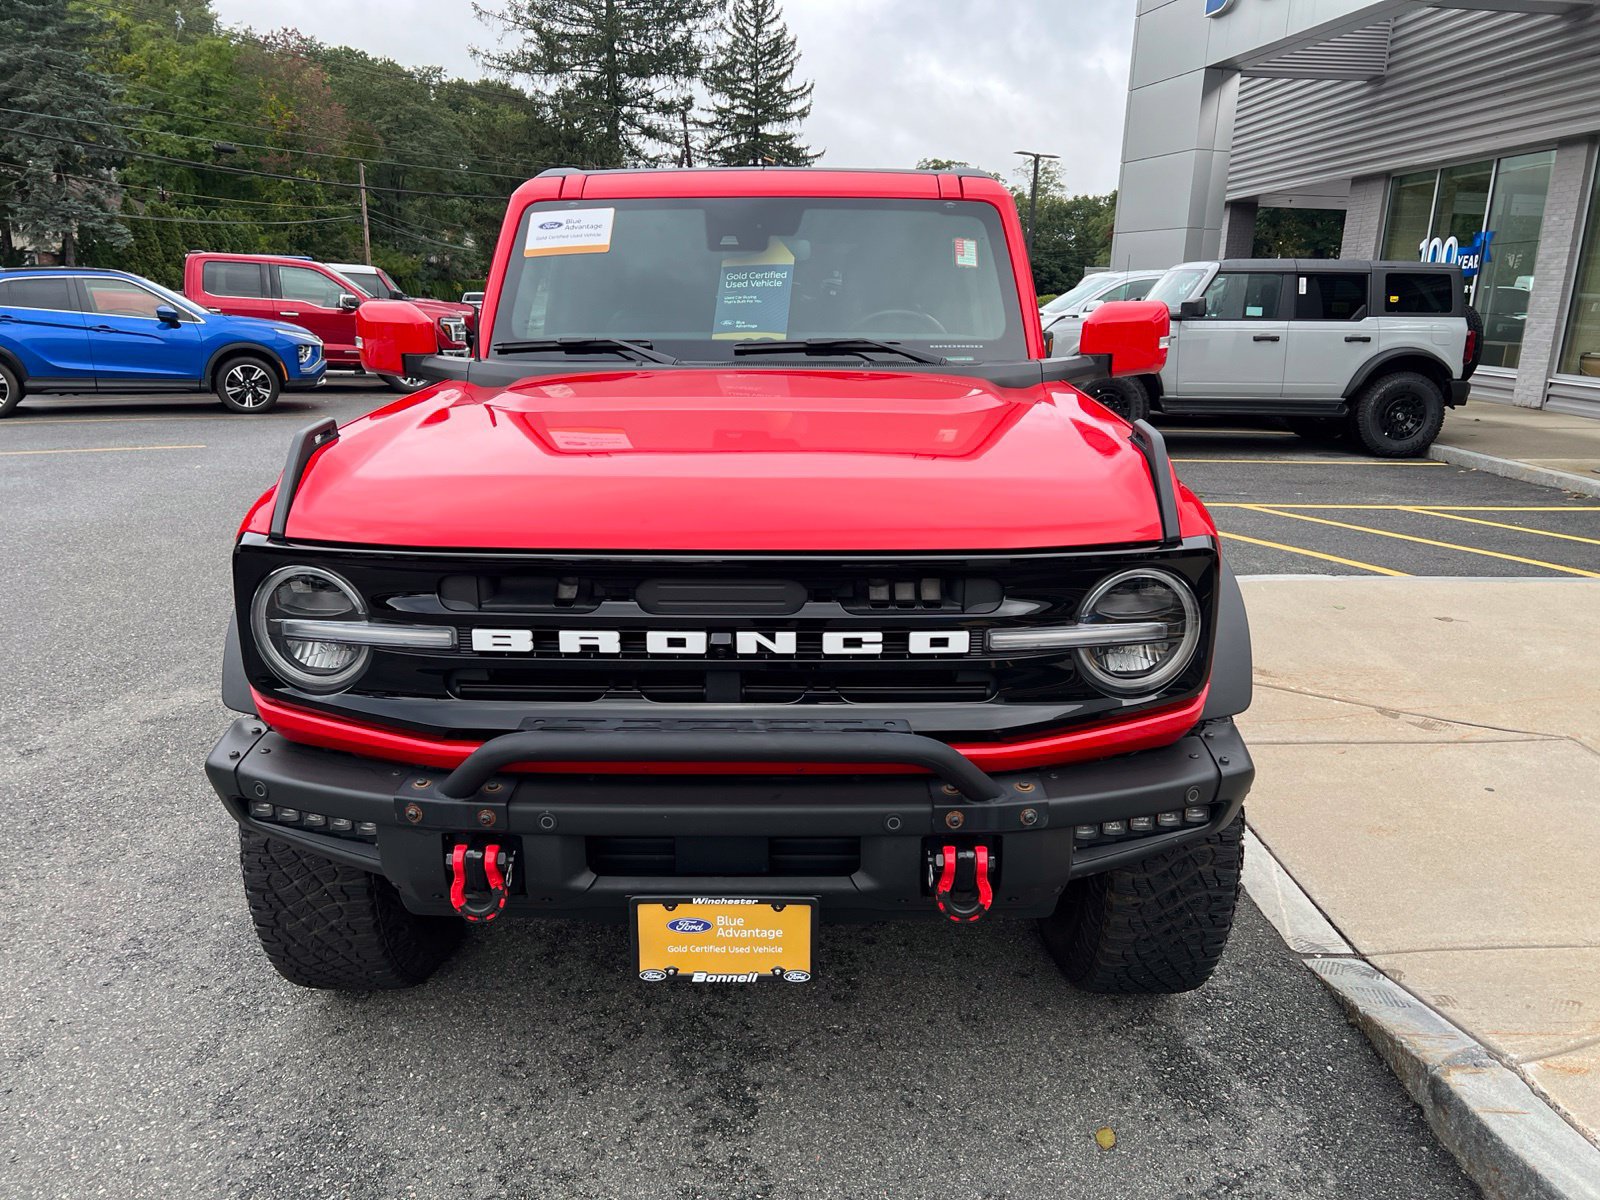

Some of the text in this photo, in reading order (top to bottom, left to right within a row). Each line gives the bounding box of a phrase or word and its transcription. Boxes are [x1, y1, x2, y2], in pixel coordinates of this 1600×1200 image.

[1419, 236, 1459, 264] 100
[726, 271, 788, 280] Gold Certified
[725, 279, 783, 288] Used Vehicle
[471, 628, 969, 655] BRONCO
[692, 897, 759, 905] Winchester
[716, 915, 745, 927] Blue
[716, 927, 783, 940] Advantage
[667, 945, 783, 953] Gold Certified Used Vehicle
[692, 972, 759, 983] Bonnell
